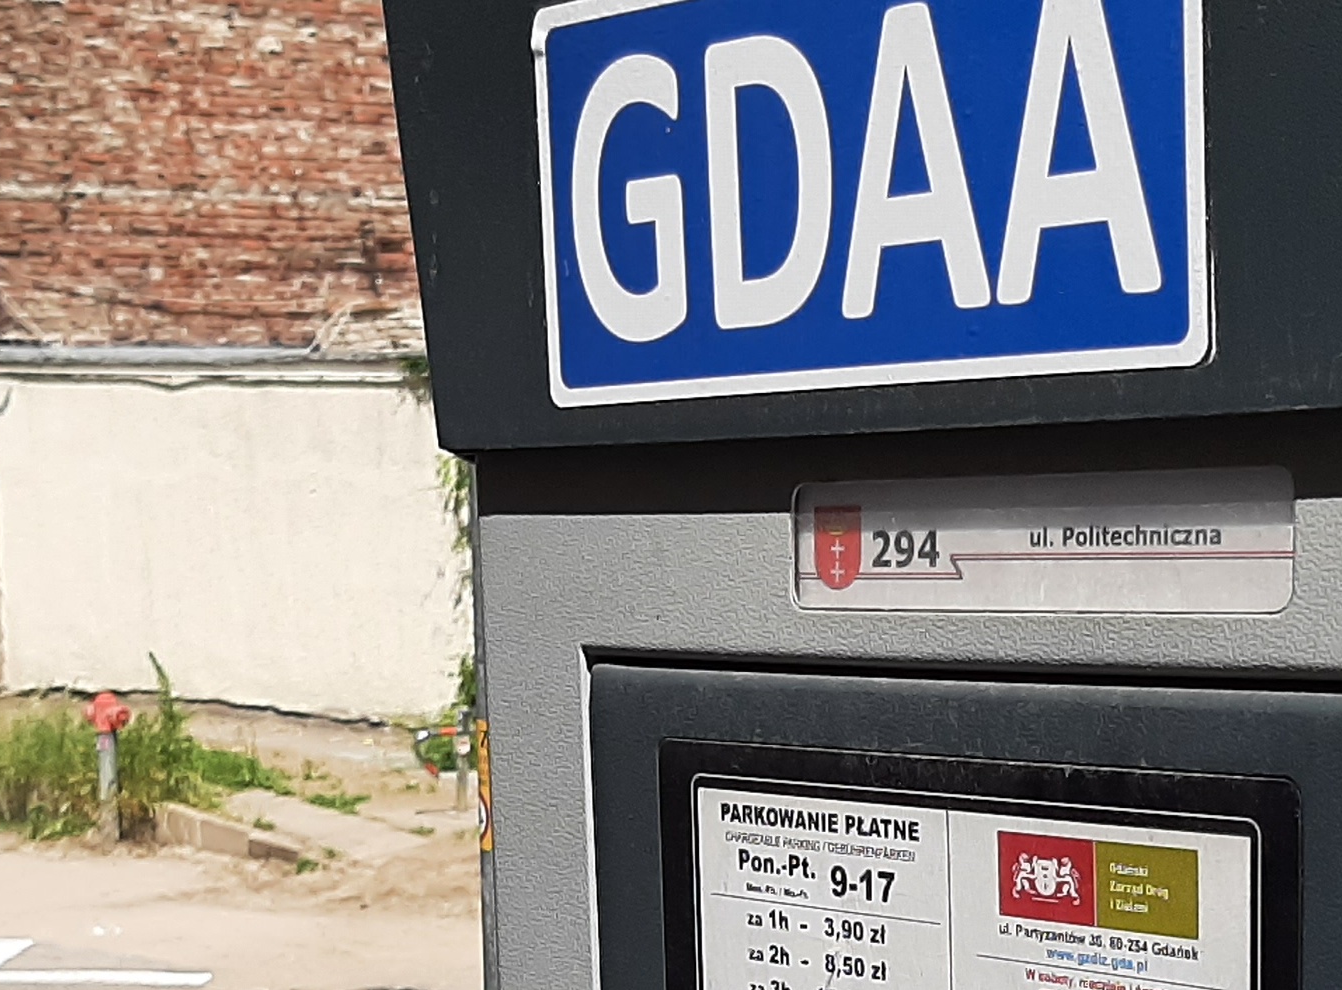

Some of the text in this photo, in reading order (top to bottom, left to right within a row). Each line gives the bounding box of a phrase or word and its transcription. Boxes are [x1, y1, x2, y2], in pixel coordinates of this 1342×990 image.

[572, 0, 1162, 342] GDAA
[871, 529, 941, 568] 294
[1028, 524, 1224, 548] ul. Politechniczna
[720, 802, 920, 842] PARKOWANIE PŁATNE
[738, 848, 816, 879] Pon.-Pt.
[830, 864, 896, 902] 9-17
[747, 913, 763, 927] za
[768, 909, 789, 931] 1h
[823, 917, 864, 942] 3,90
[870, 924, 886, 945] zł
[748, 948, 764, 962] za
[769, 945, 790, 966] 2h
[824, 953, 865, 978] 8,50
[871, 961, 887, 981] zł
